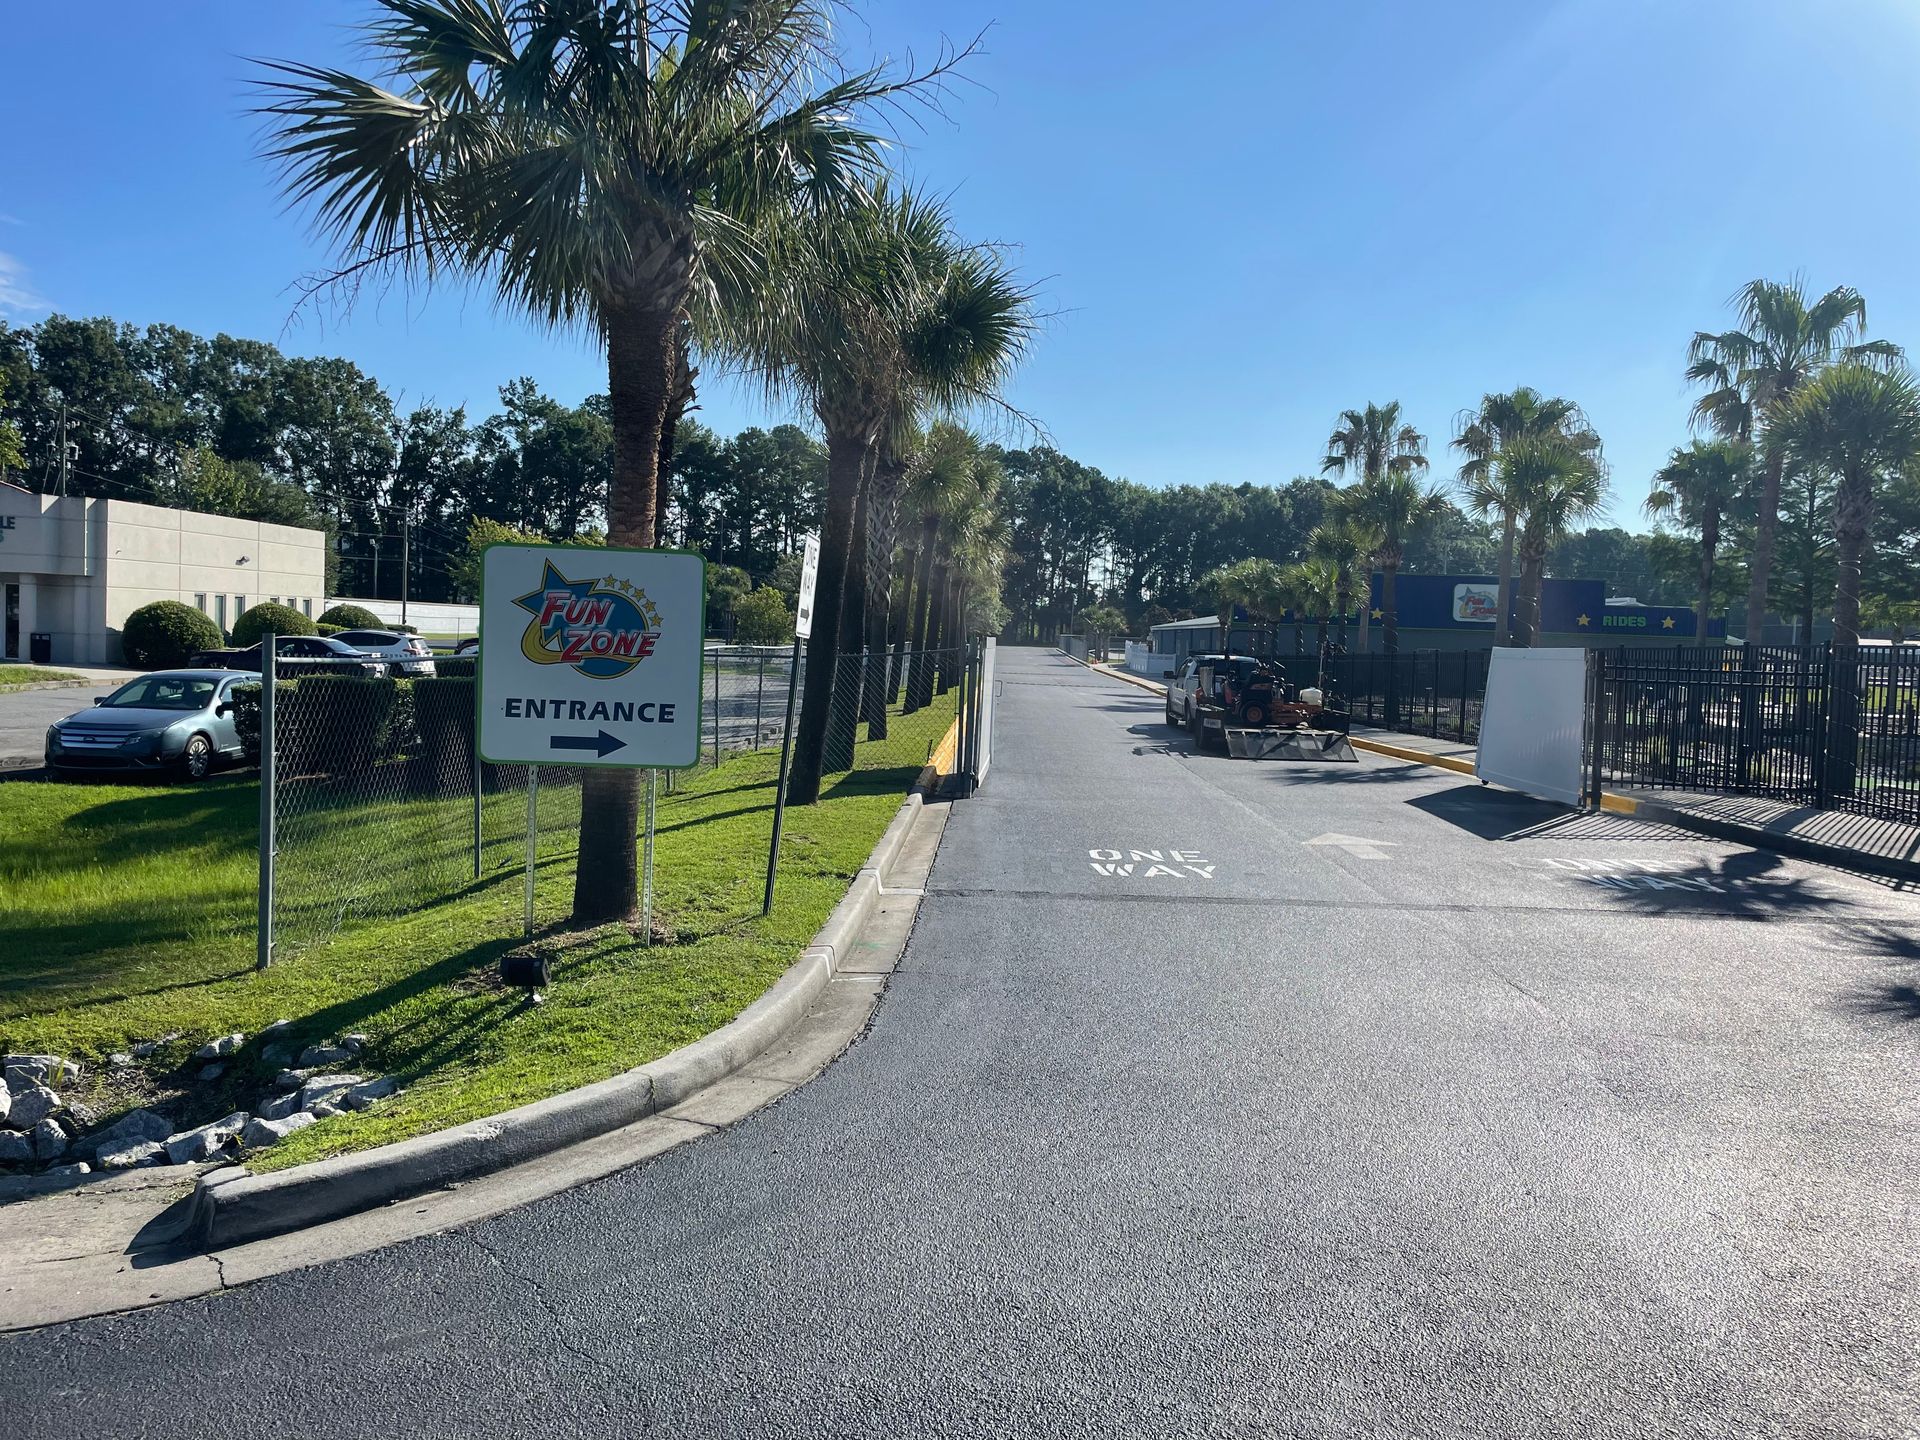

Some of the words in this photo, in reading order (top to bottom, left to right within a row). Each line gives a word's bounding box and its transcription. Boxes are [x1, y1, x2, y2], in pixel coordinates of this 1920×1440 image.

[540, 592, 613, 626] FUN
[1602, 615, 1646, 627] RIDES
[560, 629, 661, 664] ZONE
[504, 698, 676, 723] ENTRANCE
[1088, 849, 1209, 862] ONE
[1089, 862, 1217, 879] WAY
